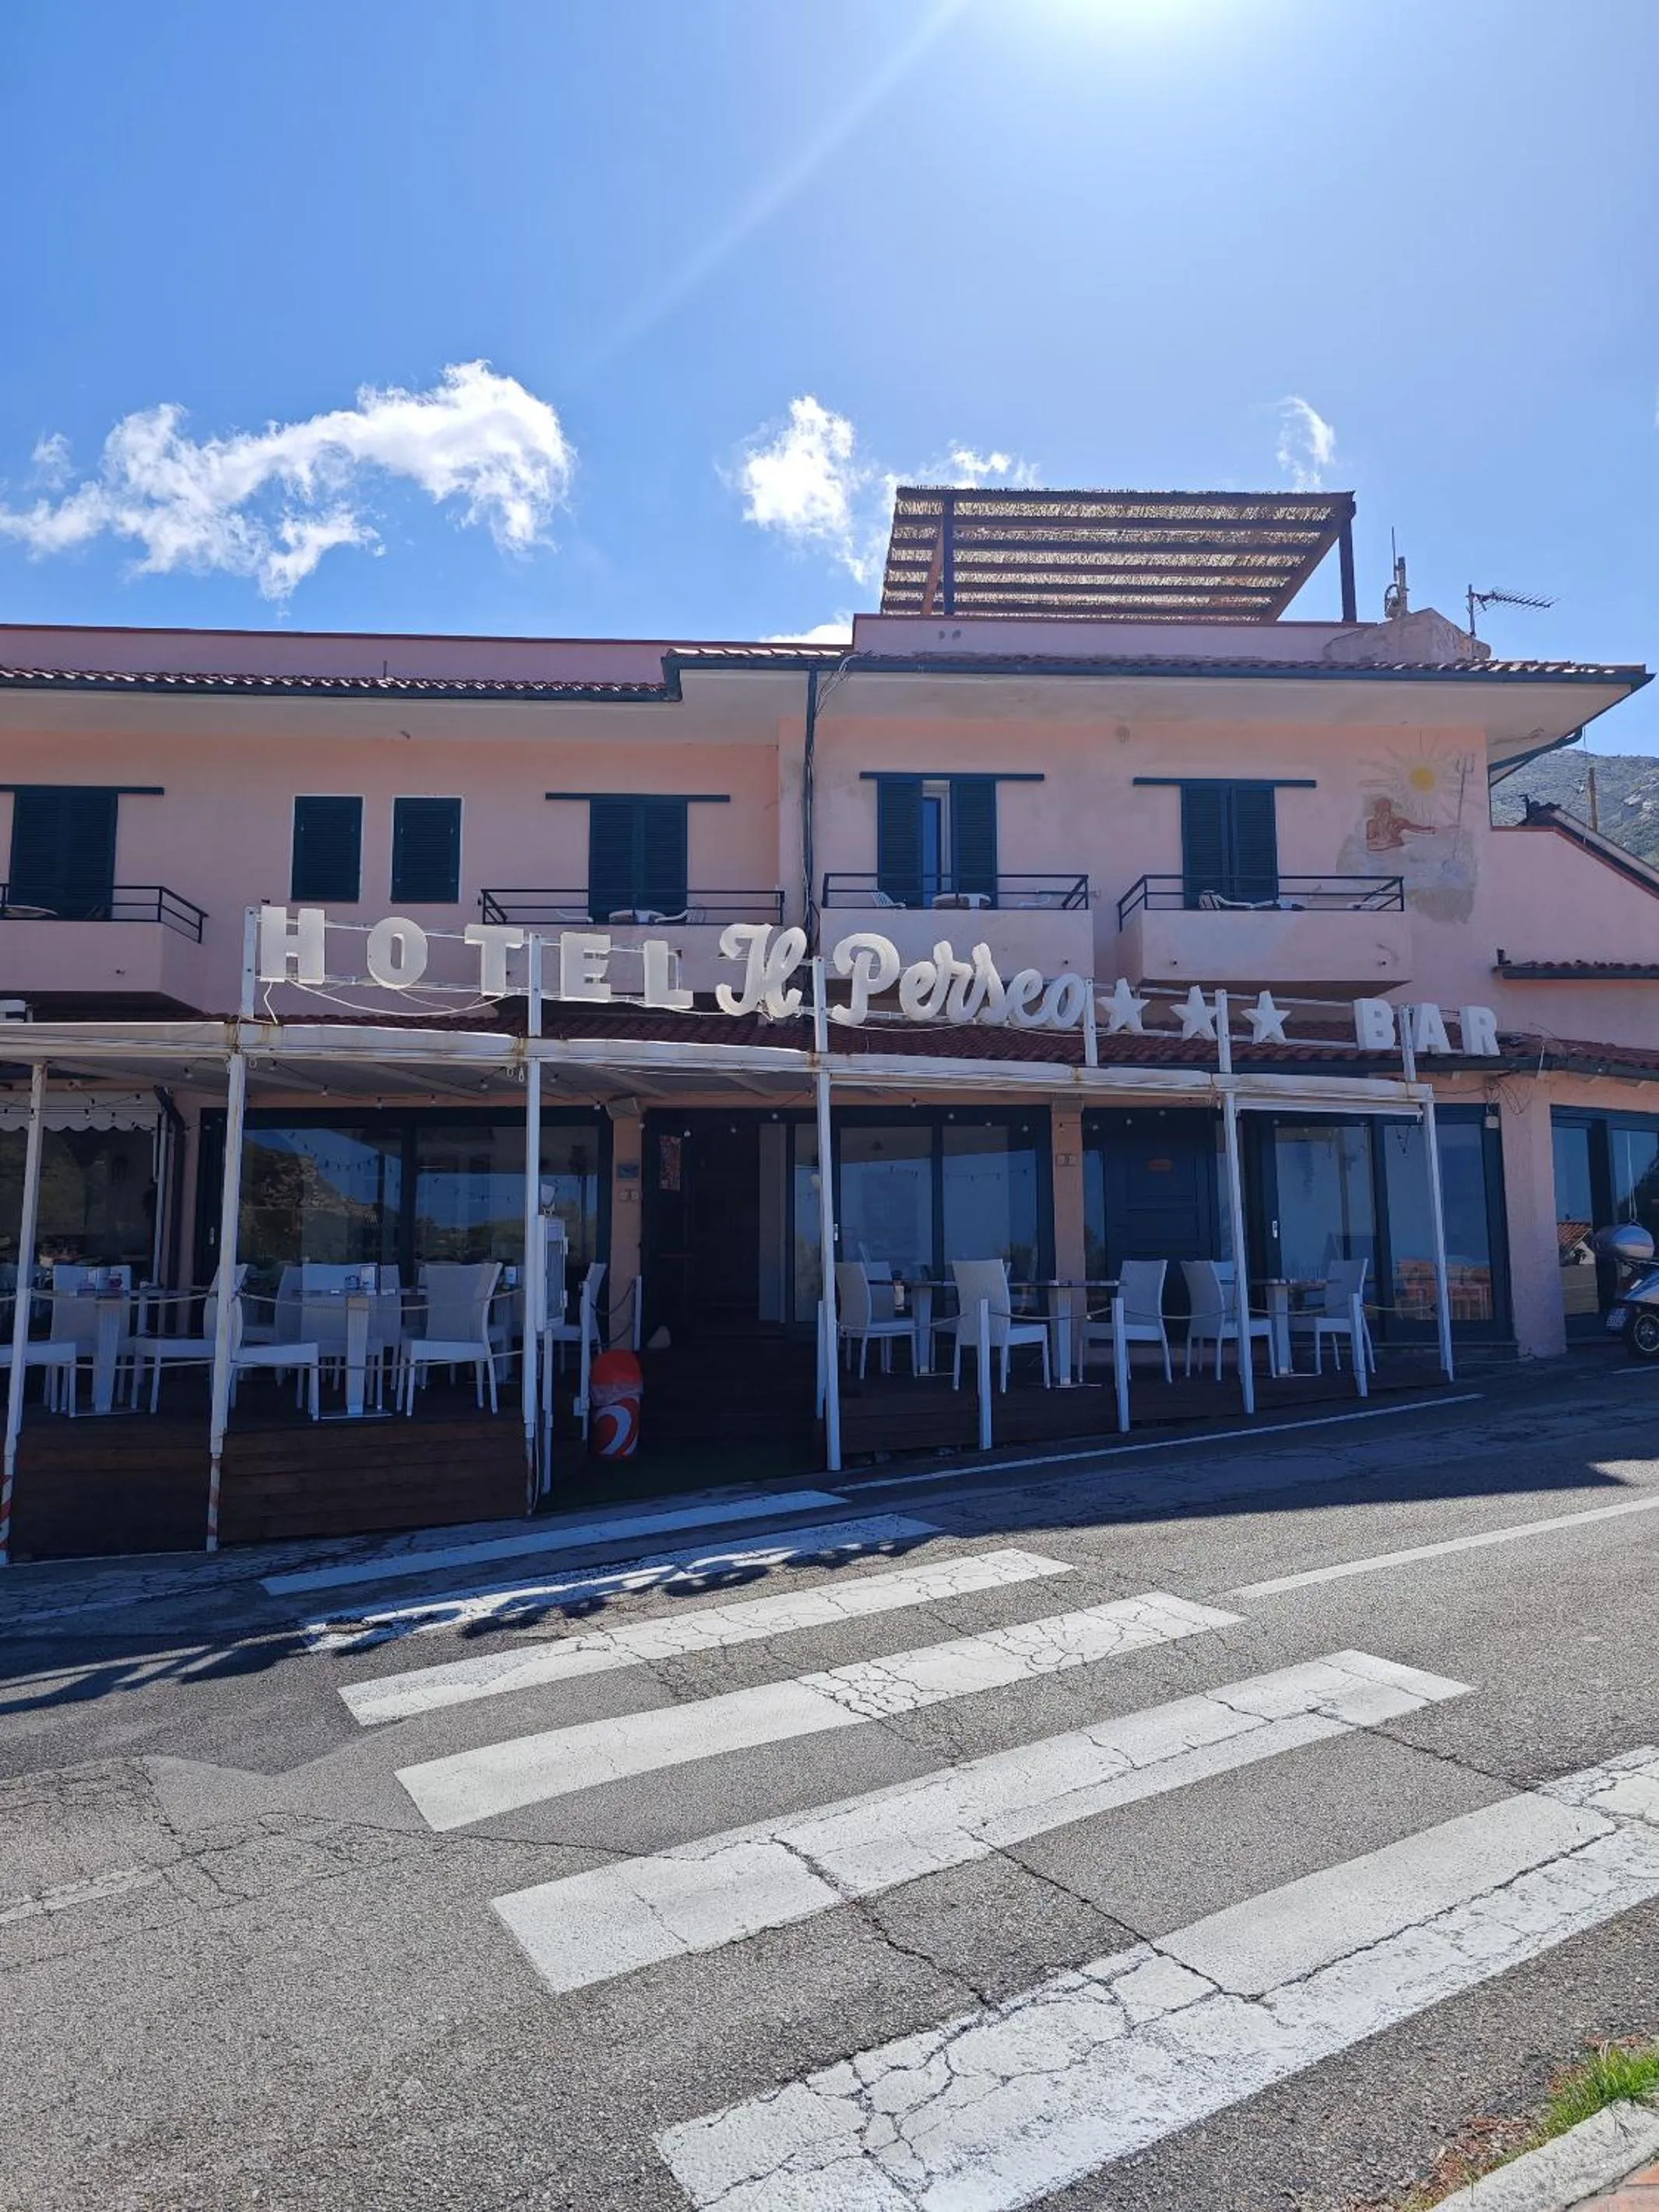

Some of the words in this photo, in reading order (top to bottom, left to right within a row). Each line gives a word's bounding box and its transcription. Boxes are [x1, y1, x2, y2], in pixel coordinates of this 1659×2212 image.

[259, 905, 693, 1009] HOTEL
[716, 924, 807, 1019] Il
[832, 932, 1087, 1029] Perseo
[1353, 998, 1500, 1057] BAR
